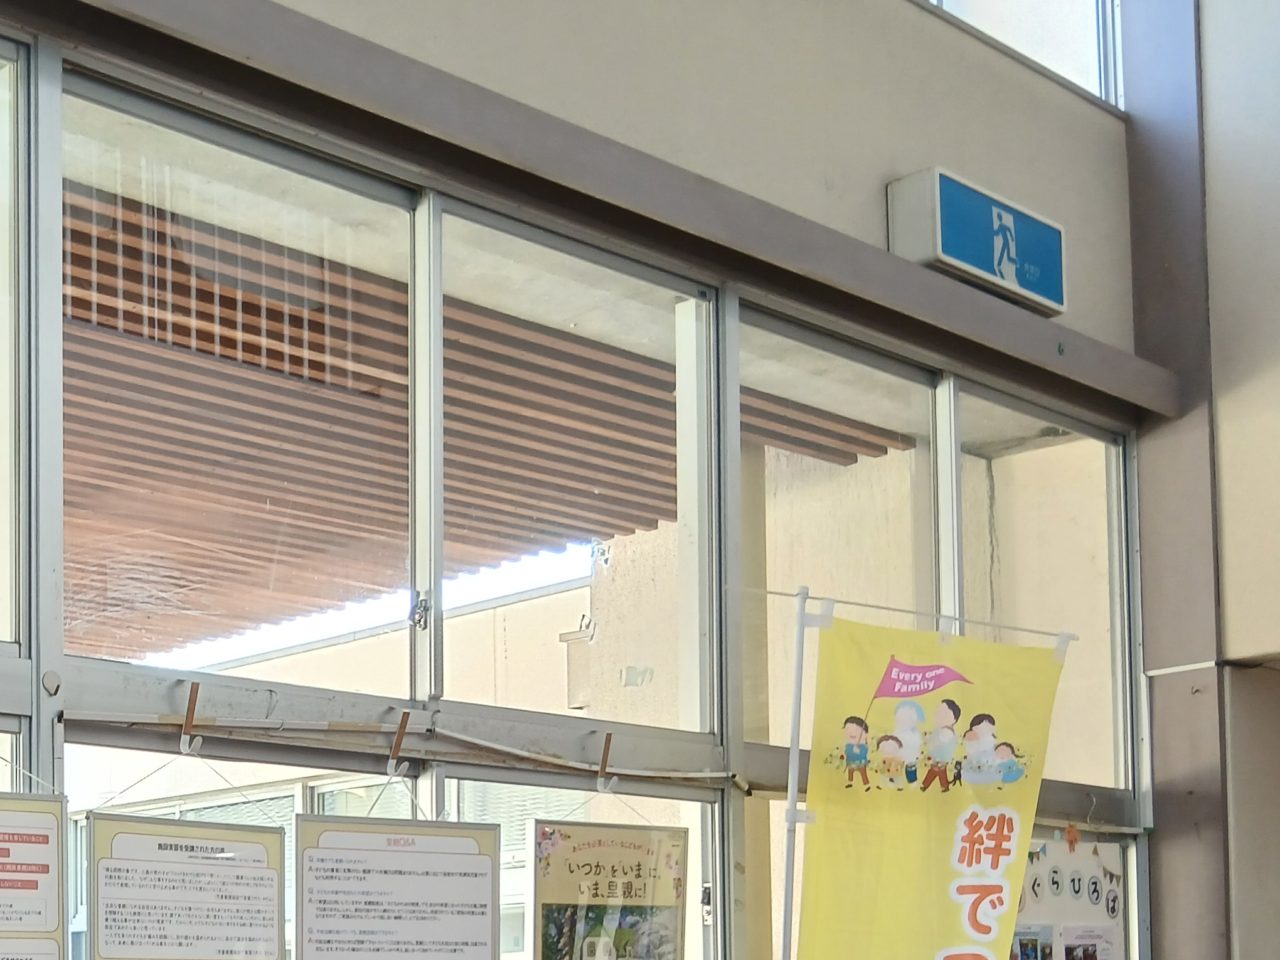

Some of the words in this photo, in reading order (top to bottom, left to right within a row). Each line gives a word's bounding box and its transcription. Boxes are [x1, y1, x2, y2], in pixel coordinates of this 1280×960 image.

[891, 668, 923, 682] Every
[925, 666, 945, 678] one
[894, 678, 935, 693] Family
[1031, 869, 1118, 915] ぐらひろば
